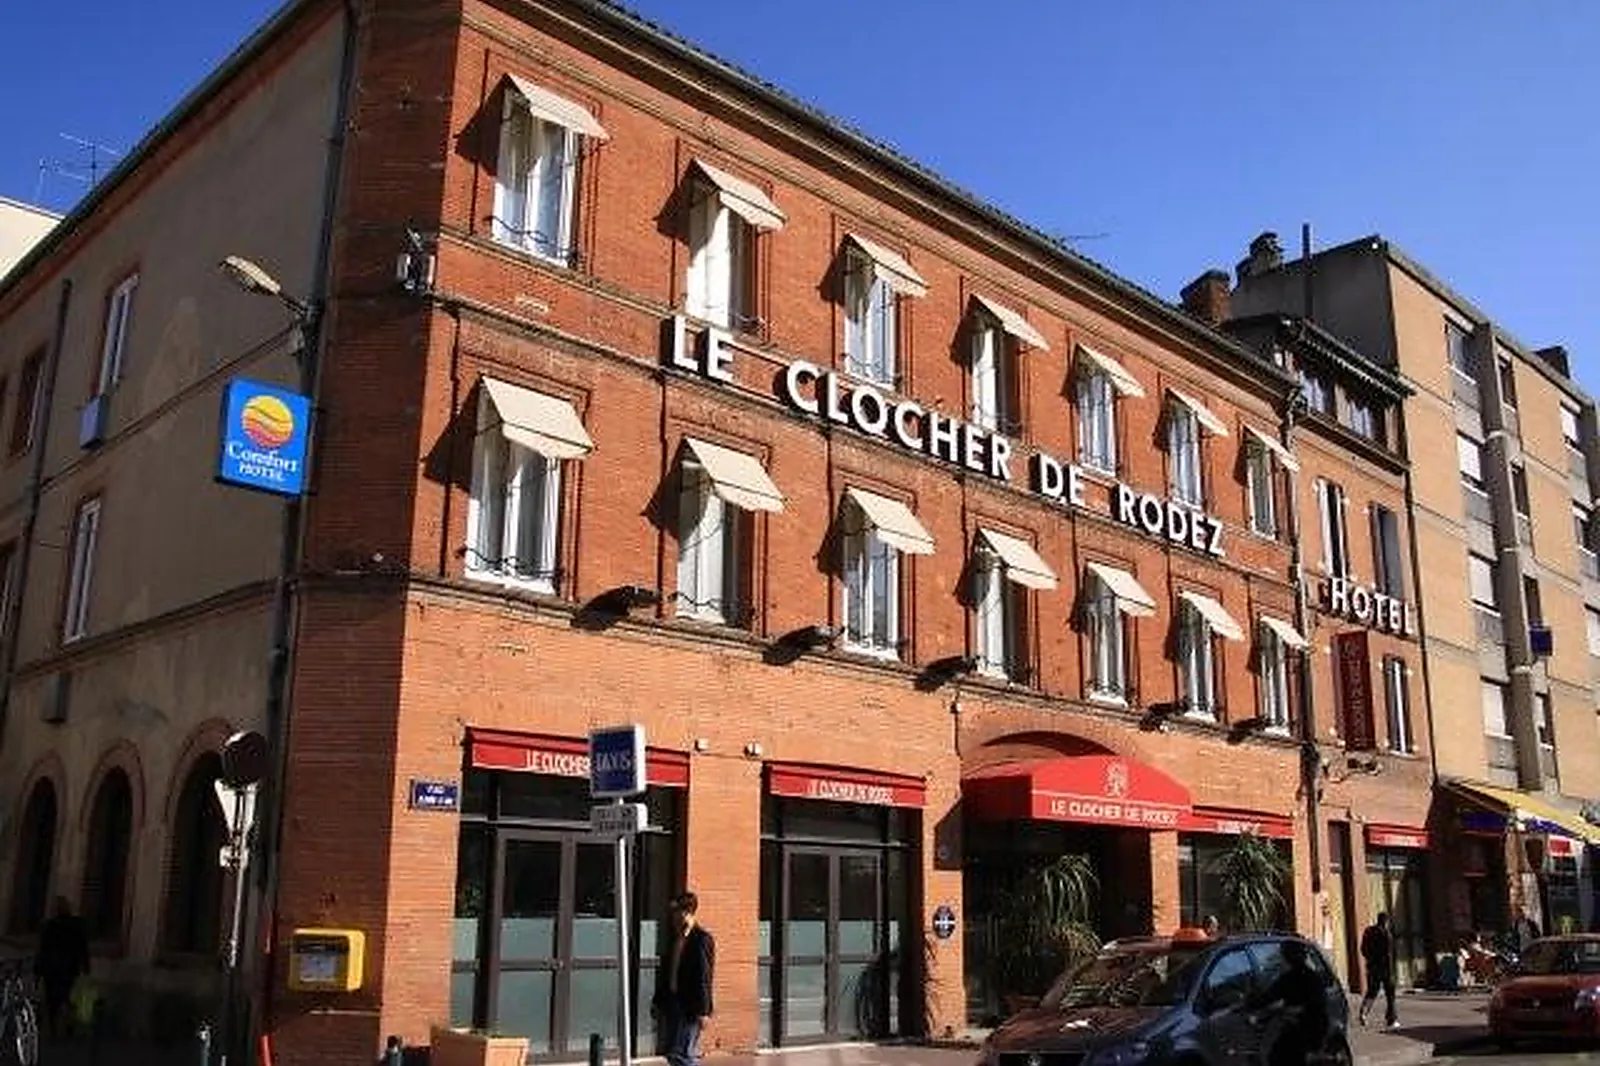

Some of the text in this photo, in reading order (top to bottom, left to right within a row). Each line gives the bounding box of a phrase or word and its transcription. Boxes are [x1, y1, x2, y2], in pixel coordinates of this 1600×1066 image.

[673, 315, 1226, 558] LE CLOCHER DE RODEZ
[227, 441, 297, 472] Comfort
[1330, 577, 1417, 634] HOTEL
[526, 749, 541, 770] LE
[1051, 800, 1066, 816] LE
[1069, 801, 1121, 819] CLOCHER
